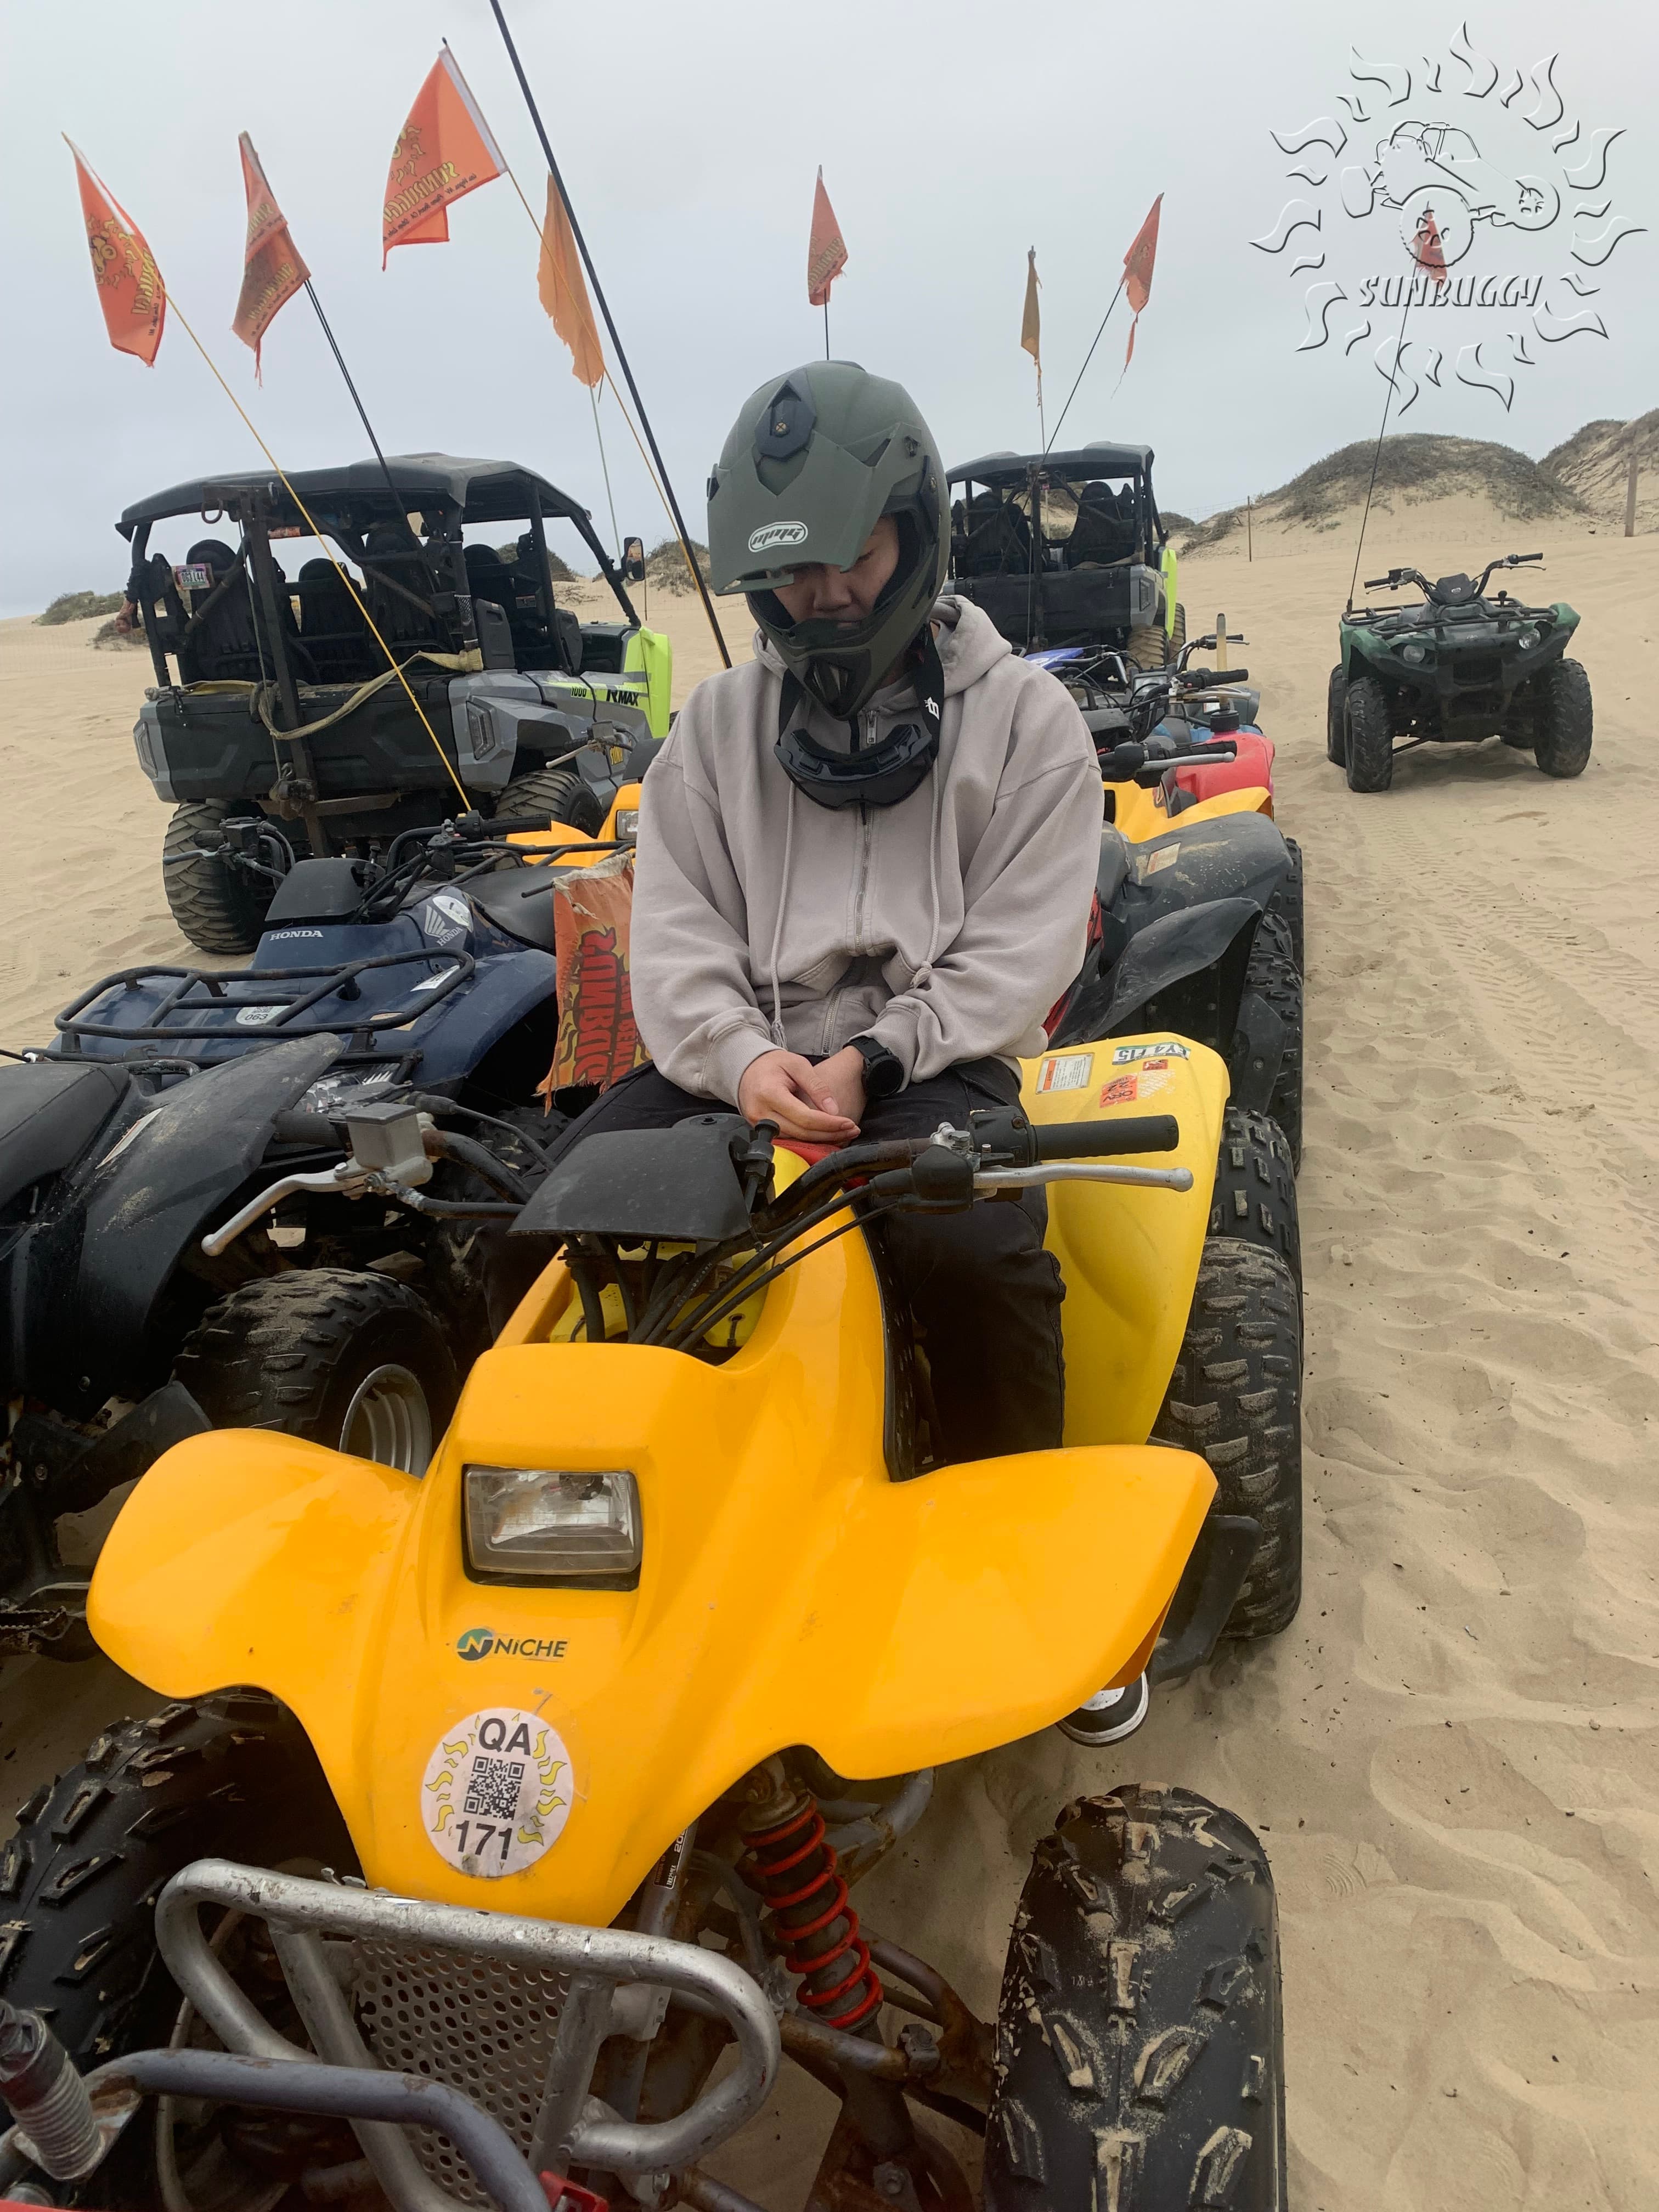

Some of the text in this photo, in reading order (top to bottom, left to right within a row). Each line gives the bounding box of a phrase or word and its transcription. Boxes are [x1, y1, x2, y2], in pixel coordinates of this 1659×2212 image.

[571, 686, 587, 698] 1000
[269, 930, 324, 941] HONDA
[437, 927, 464, 947] HONDA
[478, 1718, 531, 1756] QA
[455, 1820, 514, 1860] 171
